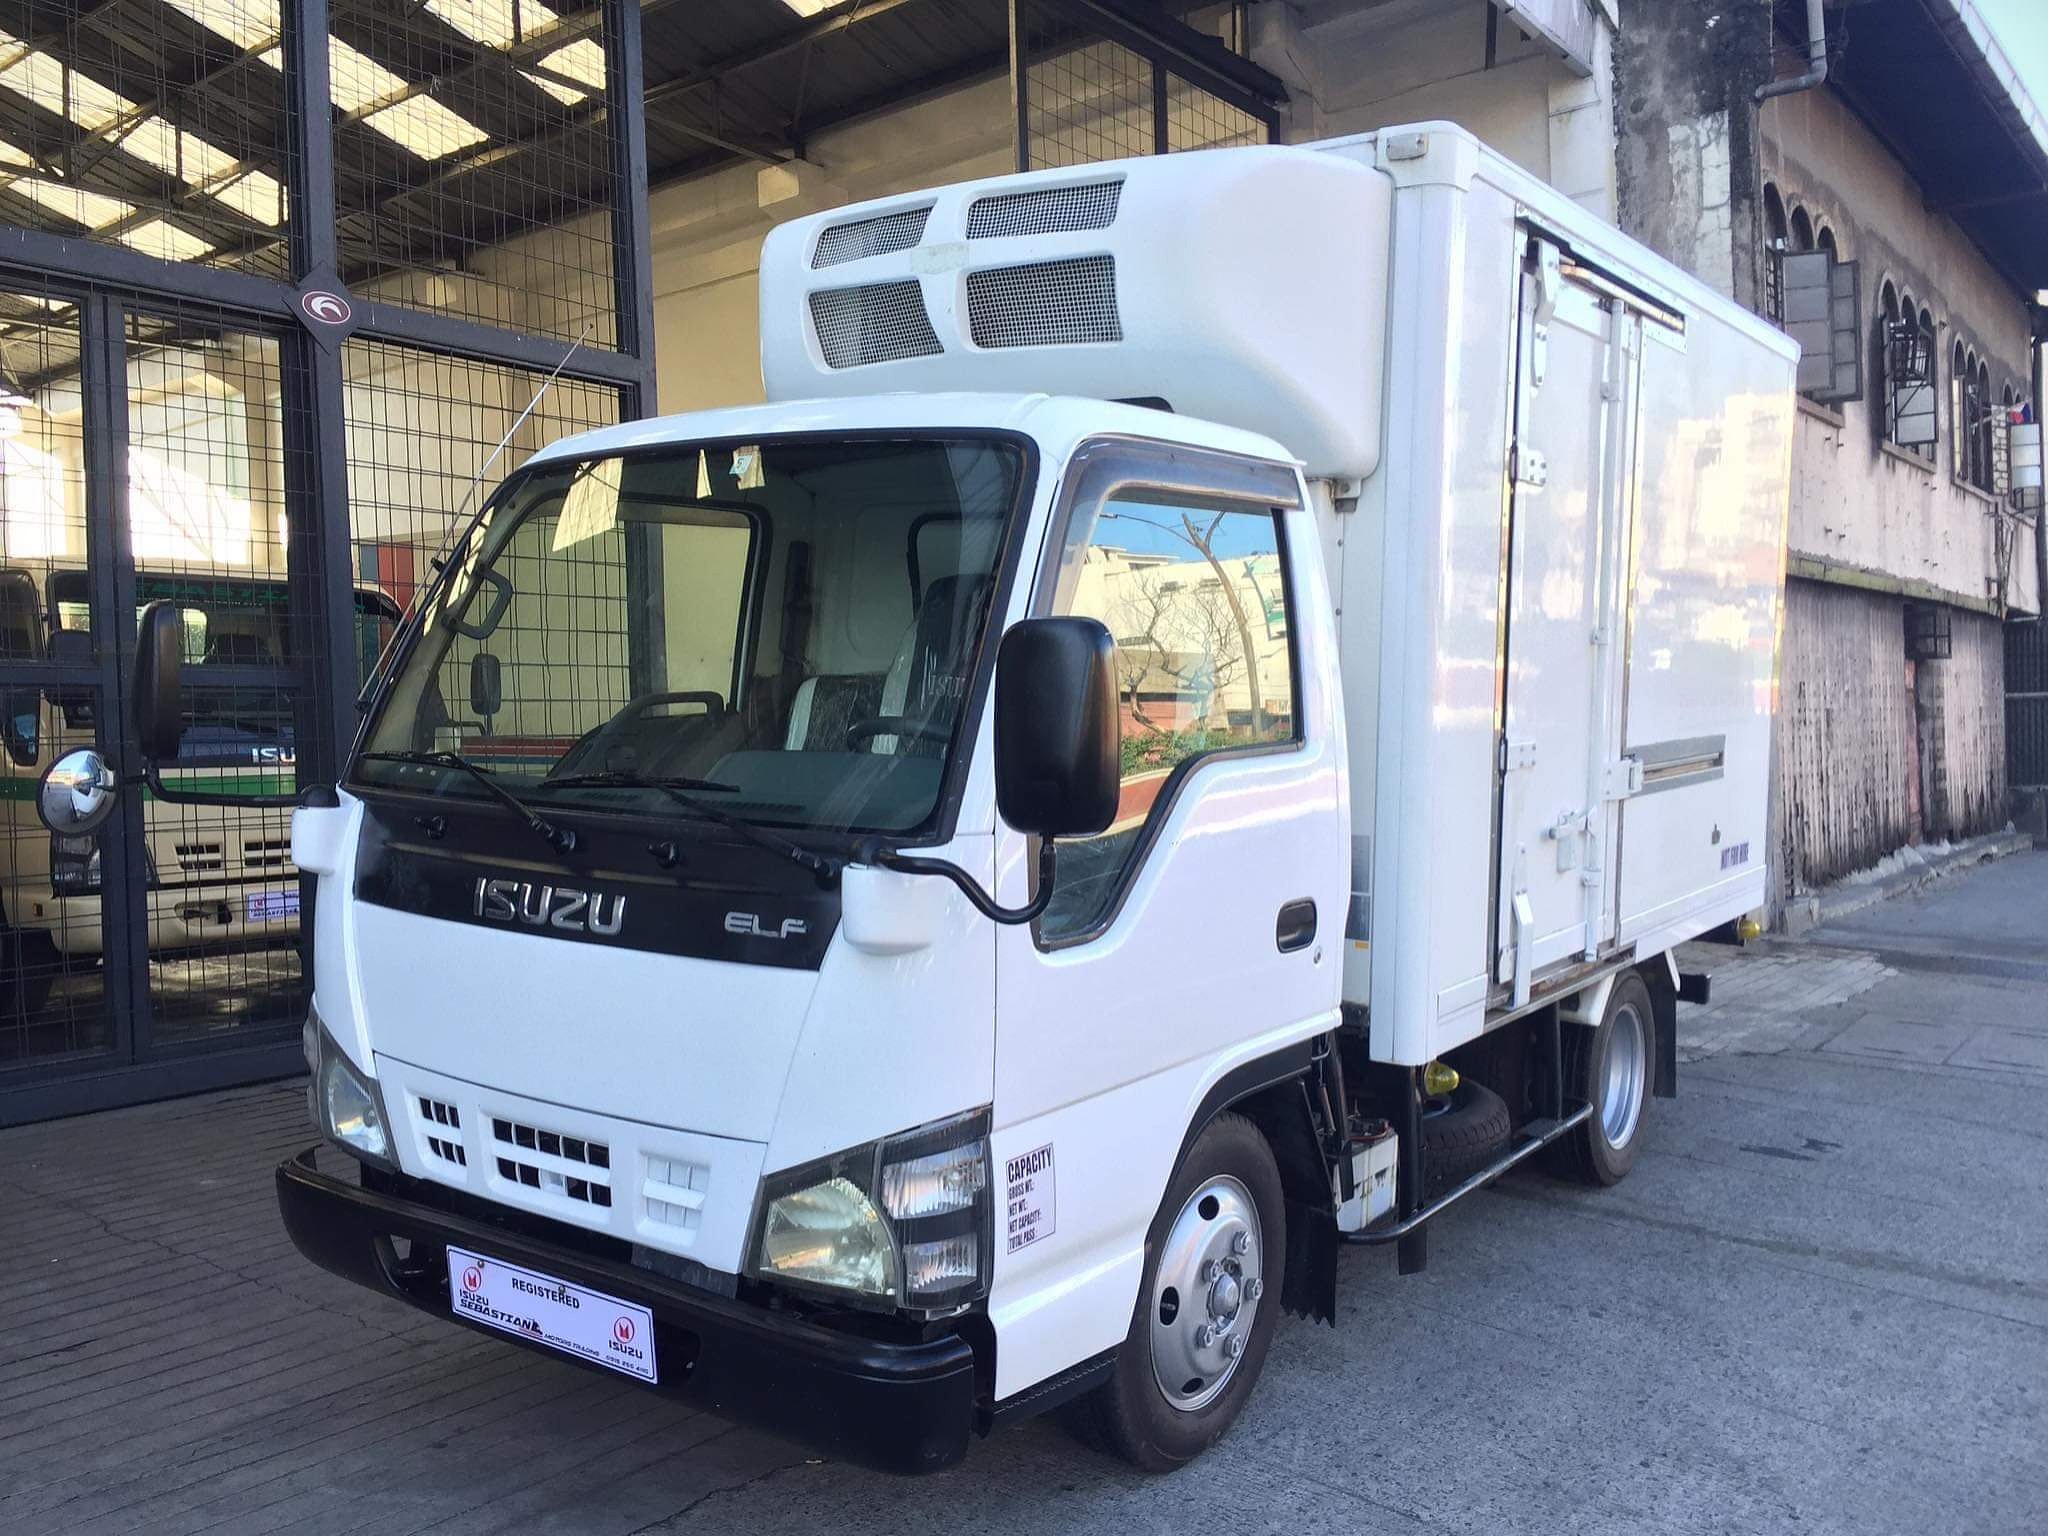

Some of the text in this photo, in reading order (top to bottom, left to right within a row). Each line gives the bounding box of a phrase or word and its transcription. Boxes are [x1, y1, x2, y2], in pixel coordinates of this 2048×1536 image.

[473, 877, 626, 936] ISUZU
[723, 911, 808, 940] ELF
[1008, 1147, 1052, 1183] CAPACITY
[1008, 1182, 1025, 1200] GROSS
[1009, 1202, 1017, 1217] NET
[1009, 1219, 1018, 1234] NET
[459, 1288, 489, 1306] ISUZU
[511, 1277, 580, 1309] REGISTERED
[460, 1298, 532, 1330] SEBASTIAN
[608, 1339, 643, 1360] ISUZU
